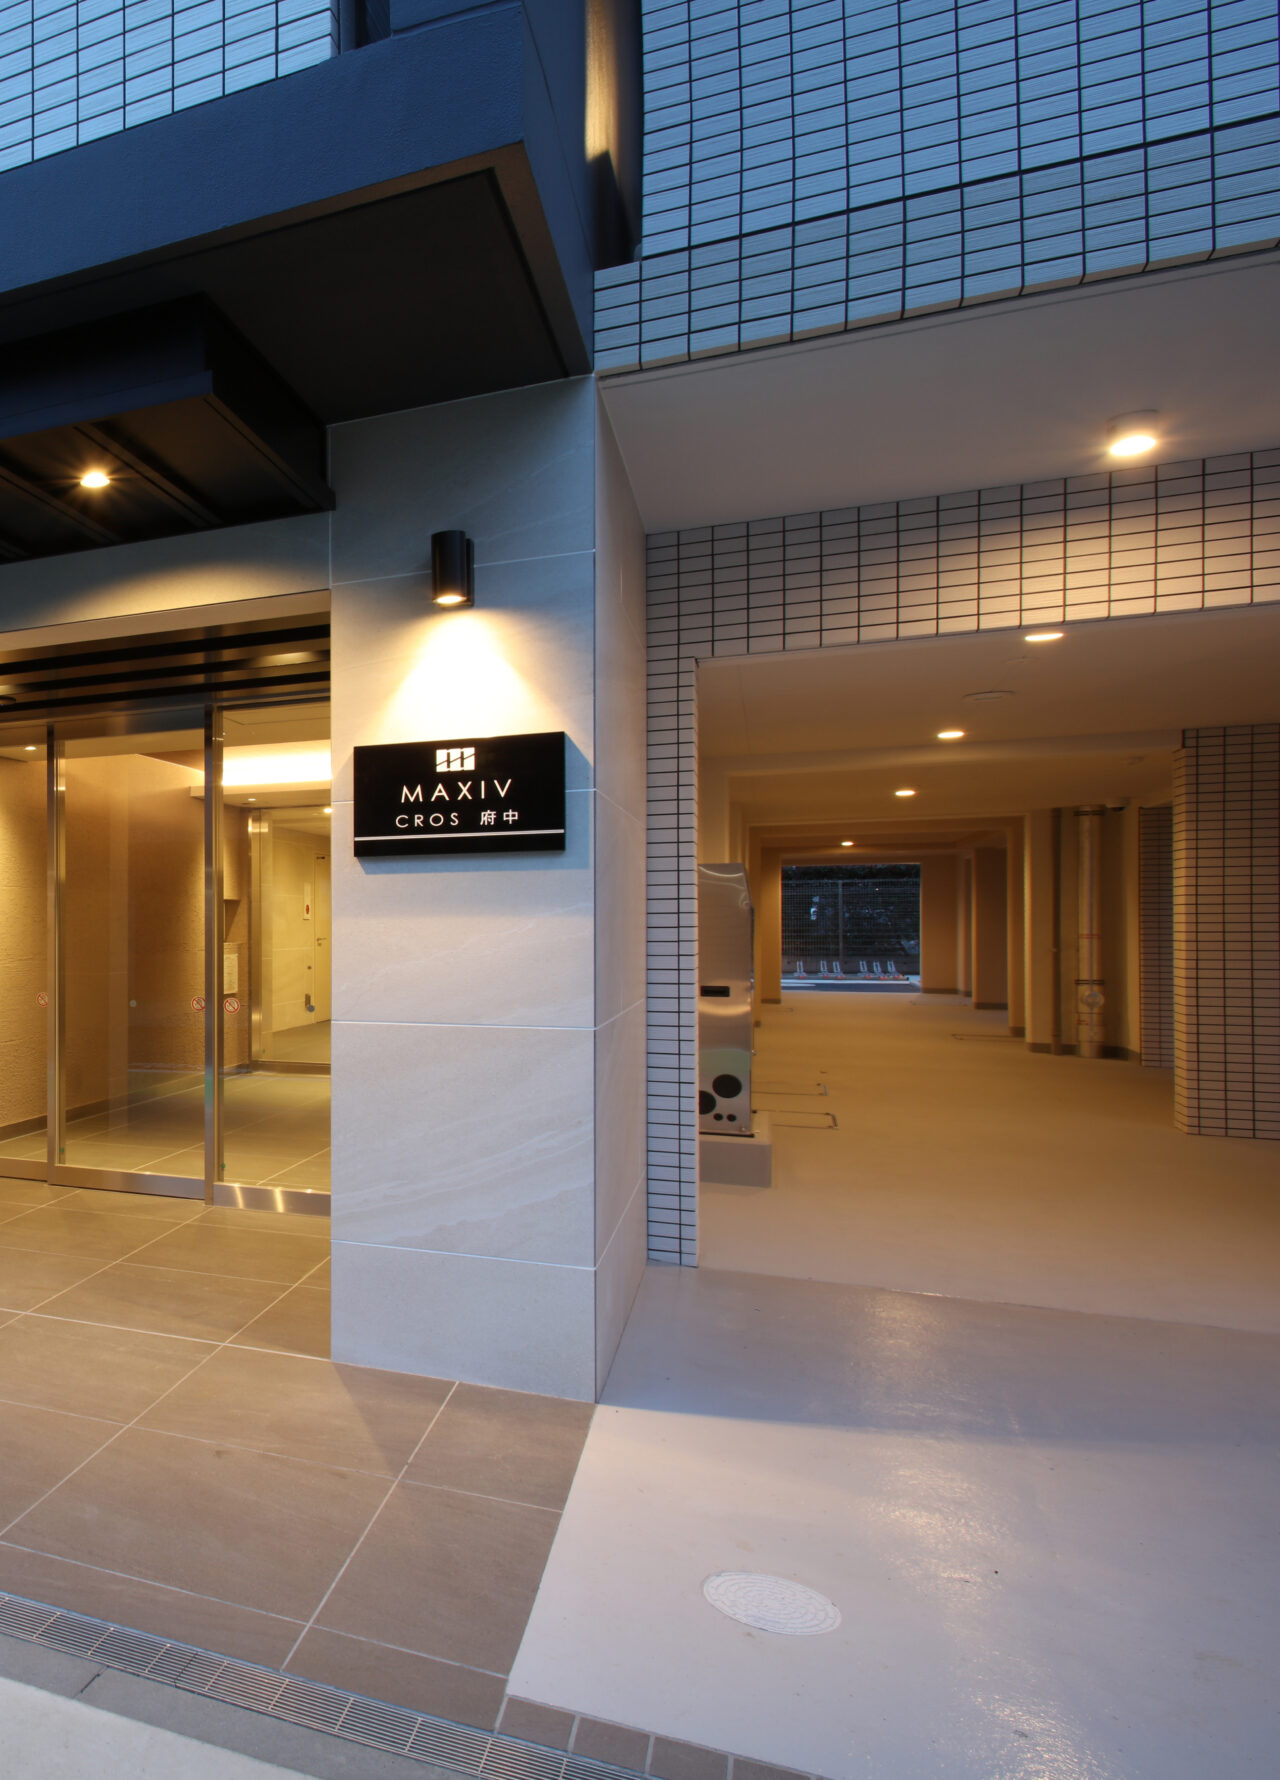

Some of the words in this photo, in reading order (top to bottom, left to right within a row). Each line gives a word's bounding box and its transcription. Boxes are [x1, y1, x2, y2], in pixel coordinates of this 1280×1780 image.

[400, 778, 512, 803] MAXIV
[395, 812, 459, 828] CROS
[479, 808, 519, 826] 府中
